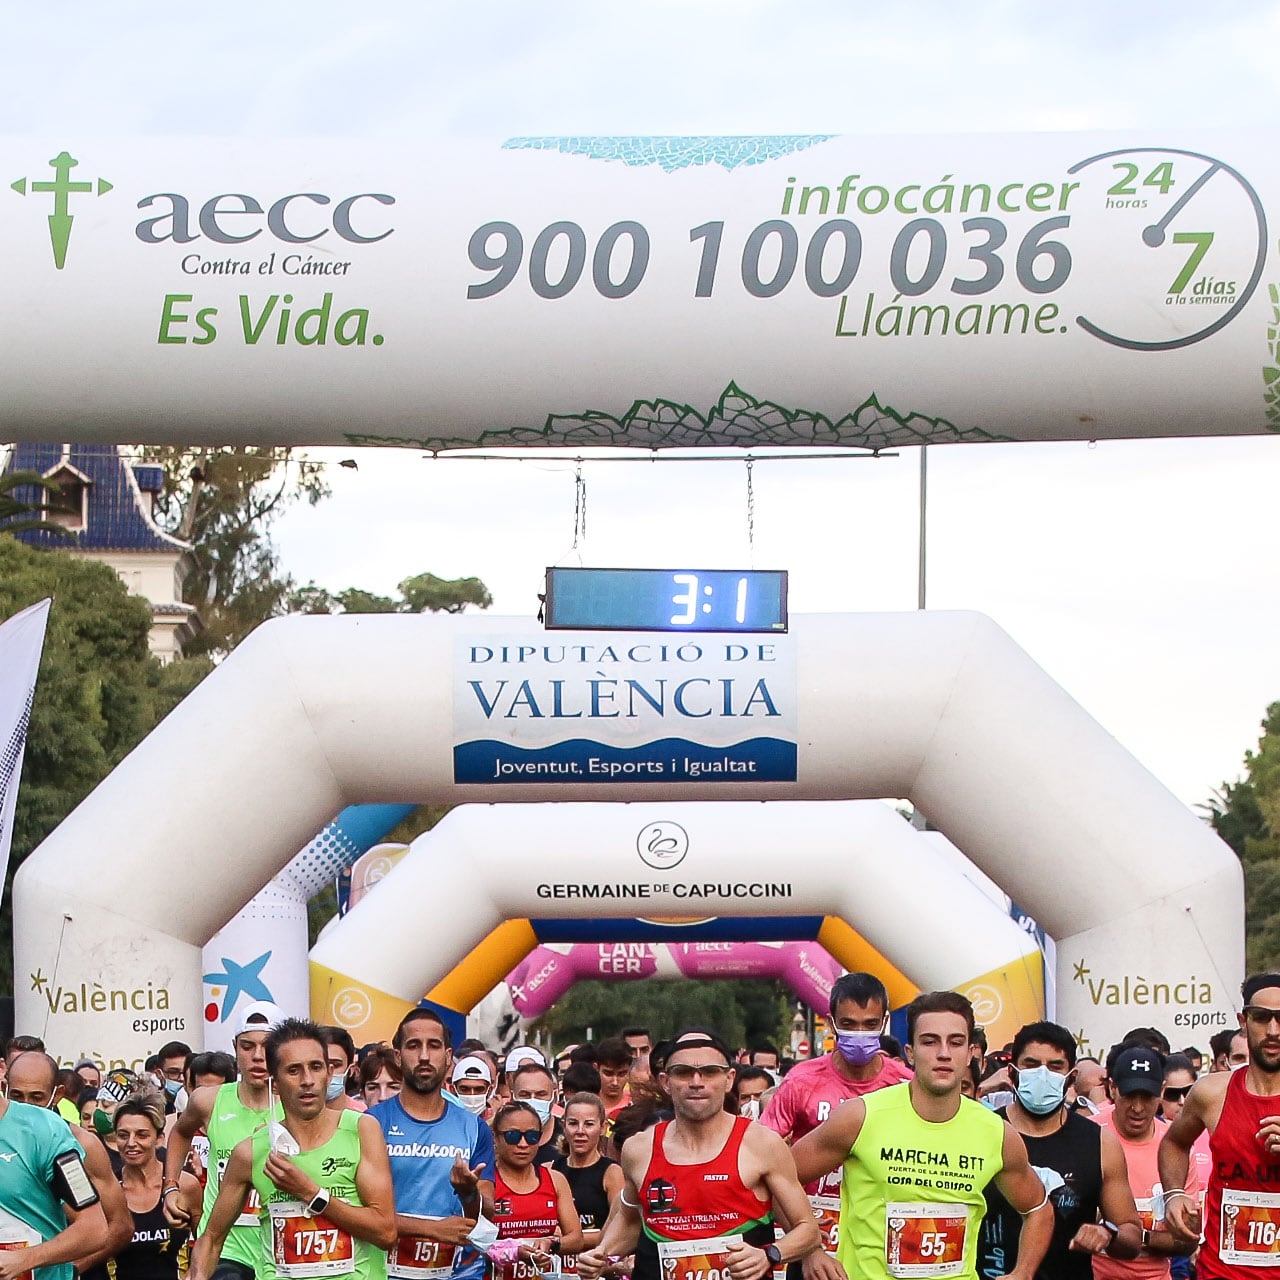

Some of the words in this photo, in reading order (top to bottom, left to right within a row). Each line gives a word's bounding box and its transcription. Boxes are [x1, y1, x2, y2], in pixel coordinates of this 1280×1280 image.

[1107, 162, 1176, 195] 24
[780, 174, 1081, 217] infocáncer
[1105, 197, 1148, 209] horas
[135, 192, 396, 244] aecc
[181, 254, 251, 275] Contra
[258, 252, 274, 275] el
[282, 254, 351, 276] Cáncer
[466, 220, 651, 300] 900
[687, 219, 863, 299] 100
[888, 215, 1073, 297] 036
[1167, 231, 1215, 294] 7
[1192, 276, 1236, 295] días
[1165, 296, 1173, 305] a
[1175, 294, 1186, 305] la
[1189, 295, 1235, 305] semana
[157, 293, 218, 345] Es
[238, 292, 385, 346] Vida.
[835, 294, 1069, 339] Llámame.
[469, 640, 704, 664] DIPUTACIÓ
[723, 643, 777, 663] DE
[466, 670, 782, 720] VALÈNCIA
[494, 757, 583, 779] Joventut,
[588, 757, 664, 777] Esports
[671, 757, 677, 773] i
[684, 756, 756, 777] Igualtat
[536, 883, 651, 899] GERMAINE
[653, 883, 670, 894] DE
[672, 882, 793, 899] CAPUCCINI
[526, 959, 558, 992] aecc
[598, 958, 642, 974] CER
[45, 981, 170, 1015] València
[1087, 974, 1212, 1006] València
[132, 1016, 185, 1036] esports
[1174, 1010, 1227, 1030] esports
[880, 1147, 949, 1168] MARCHA
[959, 1154, 985, 1172] BTT
[703, 1174, 729, 1182] FASTER
[887, 1175, 912, 1185] LOSA
[914, 1178, 933, 1188] DEL
[935, 1180, 973, 1193] OBISPO
[939, 1170, 976, 1180] SERRANIA
[691, 1214, 721, 1223] URBAN
[294, 1229, 339, 1256] 1757
[414, 1241, 440, 1263] 151
[920, 1231, 948, 1257] 55
